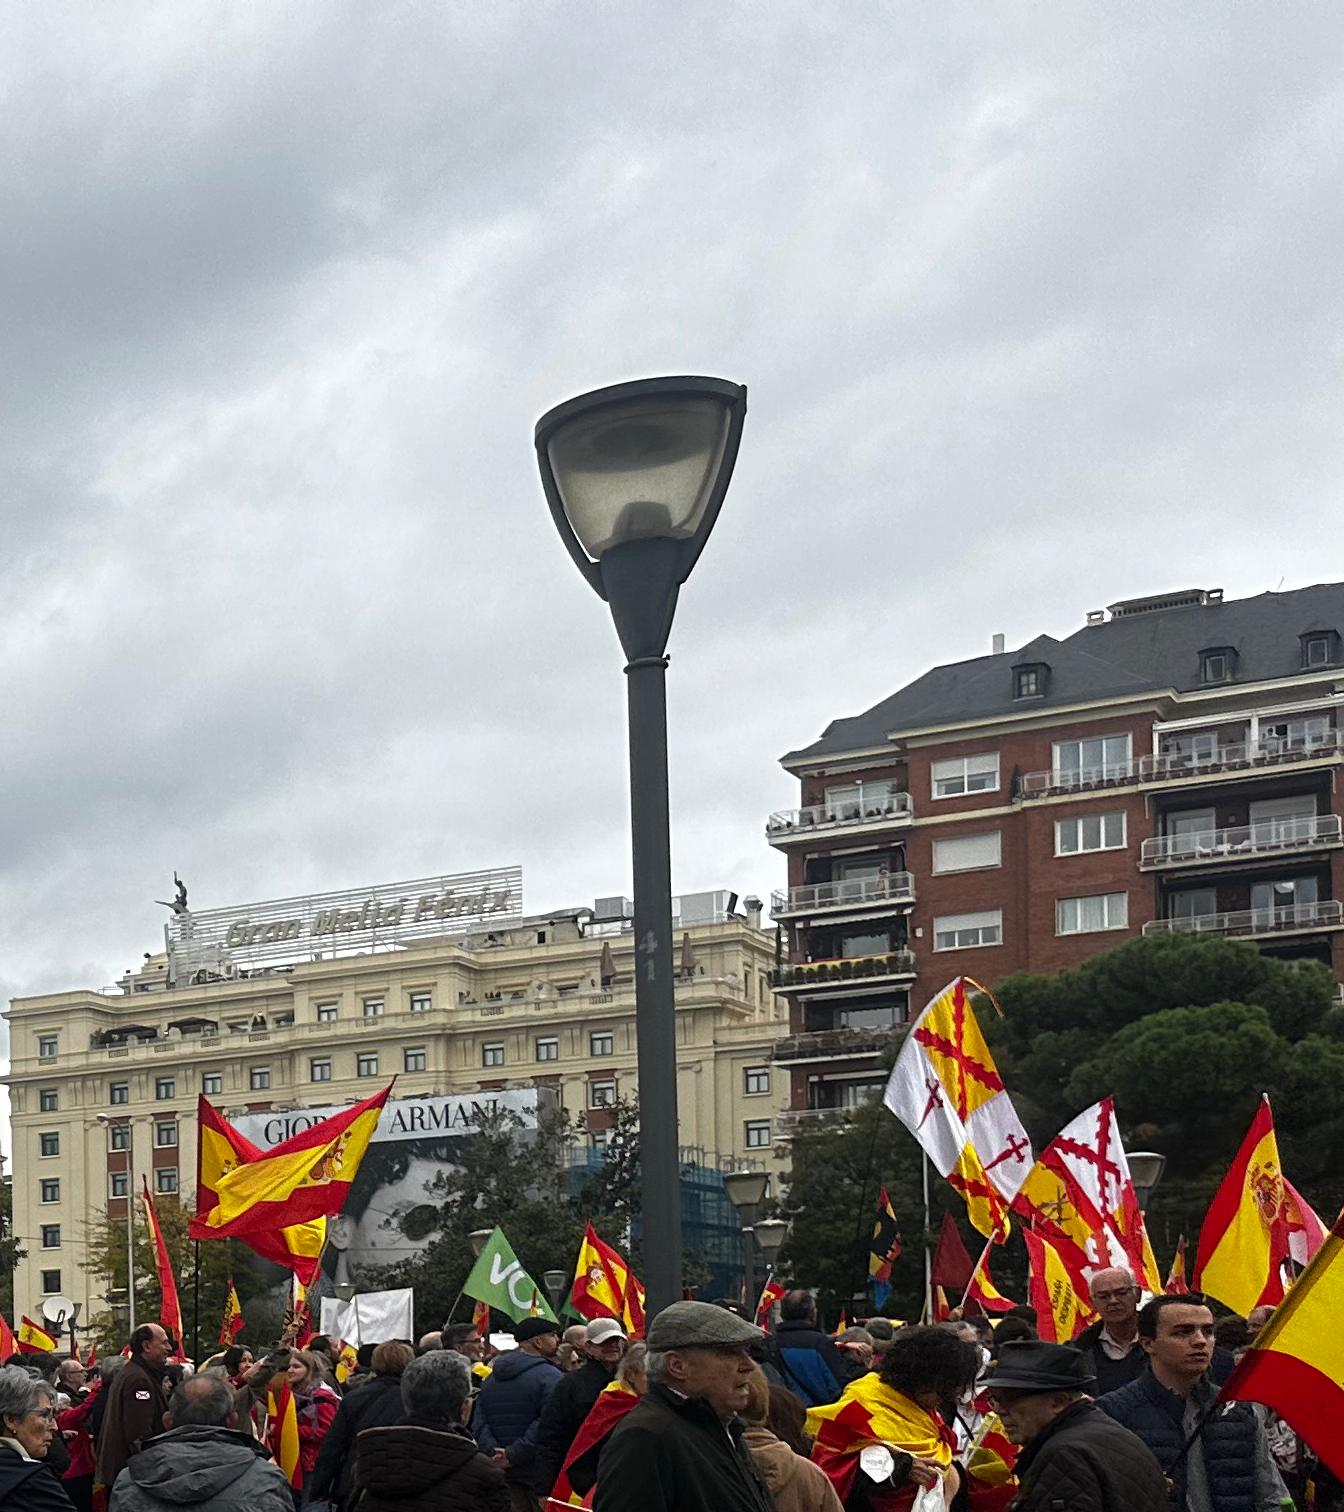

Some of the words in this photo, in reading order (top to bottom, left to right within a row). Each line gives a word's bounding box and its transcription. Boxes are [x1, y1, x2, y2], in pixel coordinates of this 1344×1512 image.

[225, 918, 301, 948] Gran
[413, 886, 511, 923] Fénix
[388, 1098, 498, 1134] ARMANI
